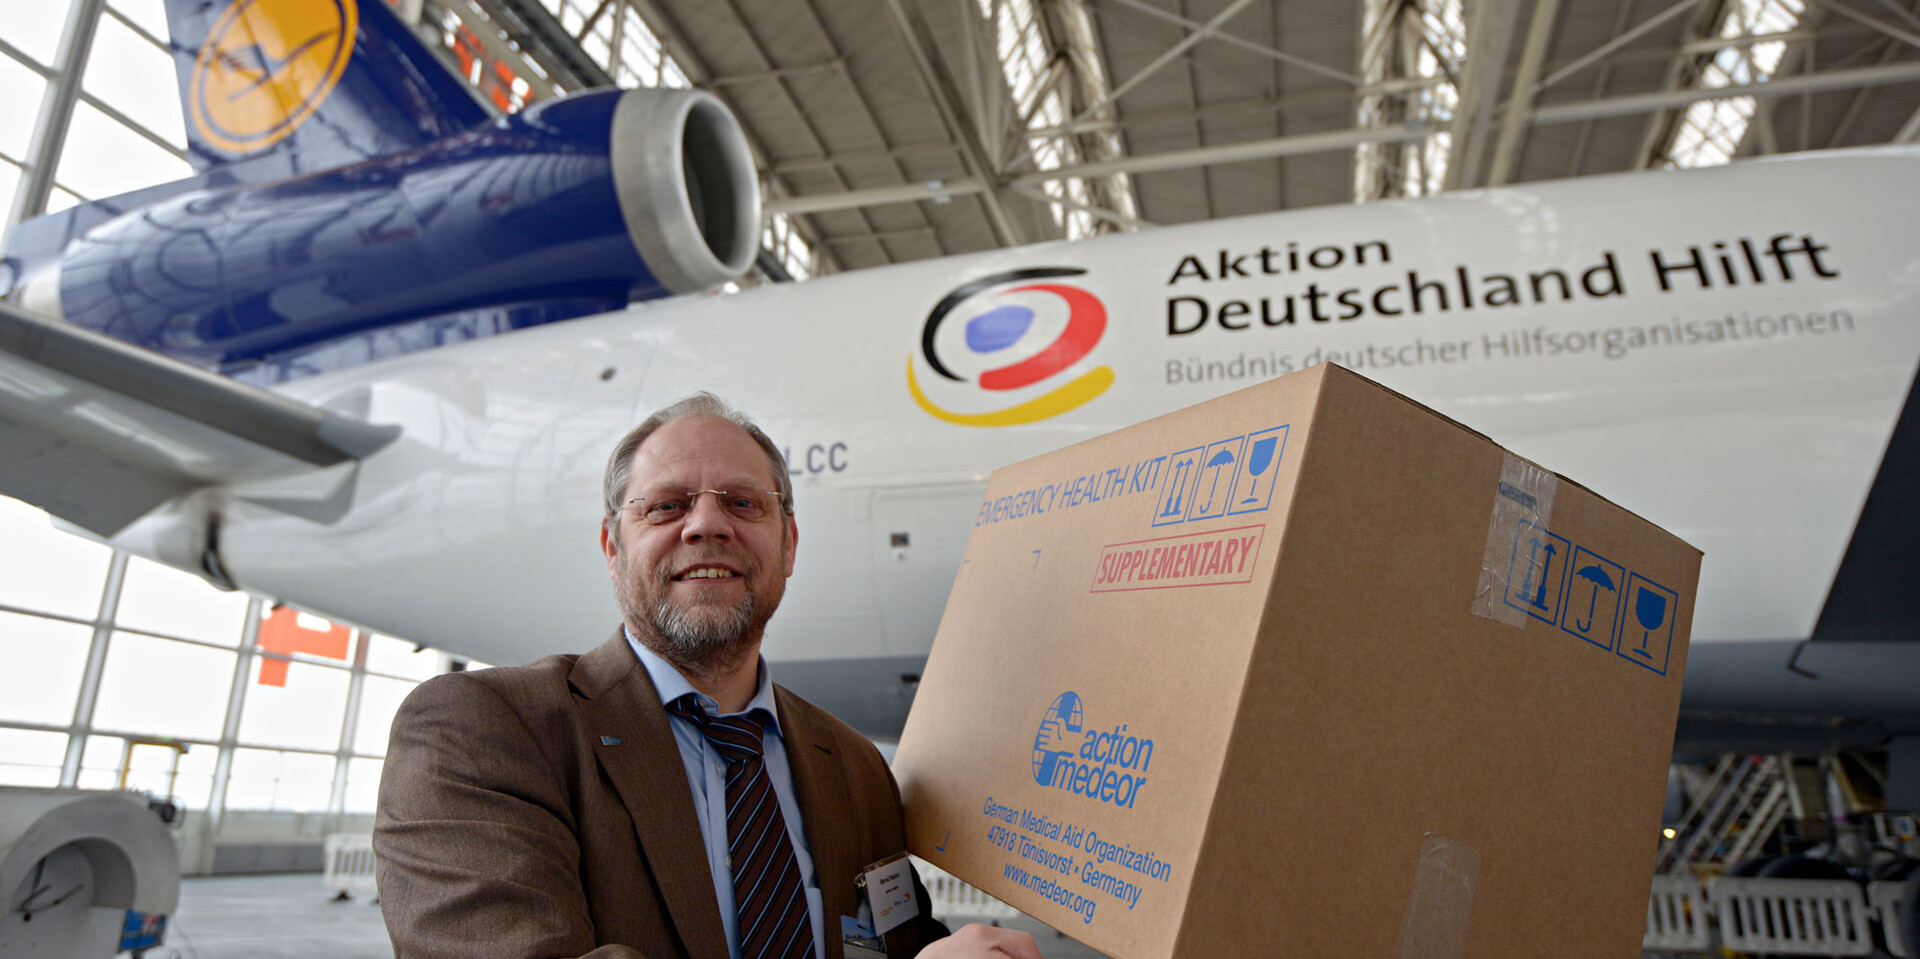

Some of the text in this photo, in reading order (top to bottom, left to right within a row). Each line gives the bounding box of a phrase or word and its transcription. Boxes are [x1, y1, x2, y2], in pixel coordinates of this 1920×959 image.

[1166, 233, 1842, 337] Deutschland Hilft
[1167, 238, 1392, 286] Aktion
[1166, 353, 1292, 385] Bündnis
[1481, 308, 1855, 361] Hilfsorganisationen
[976, 455, 1168, 527] EMERGENCY HEALTH KIT
[1097, 535, 1258, 585] SUPPLEMENTARY
[1051, 752, 1147, 809] medeor
[1079, 724, 1154, 773] action
[983, 796, 1172, 883] German Medical Aid Organization
[987, 825, 1143, 910] 47918 Tönisvorst Germany
[1003, 862, 1097, 924] www.medeor.org
